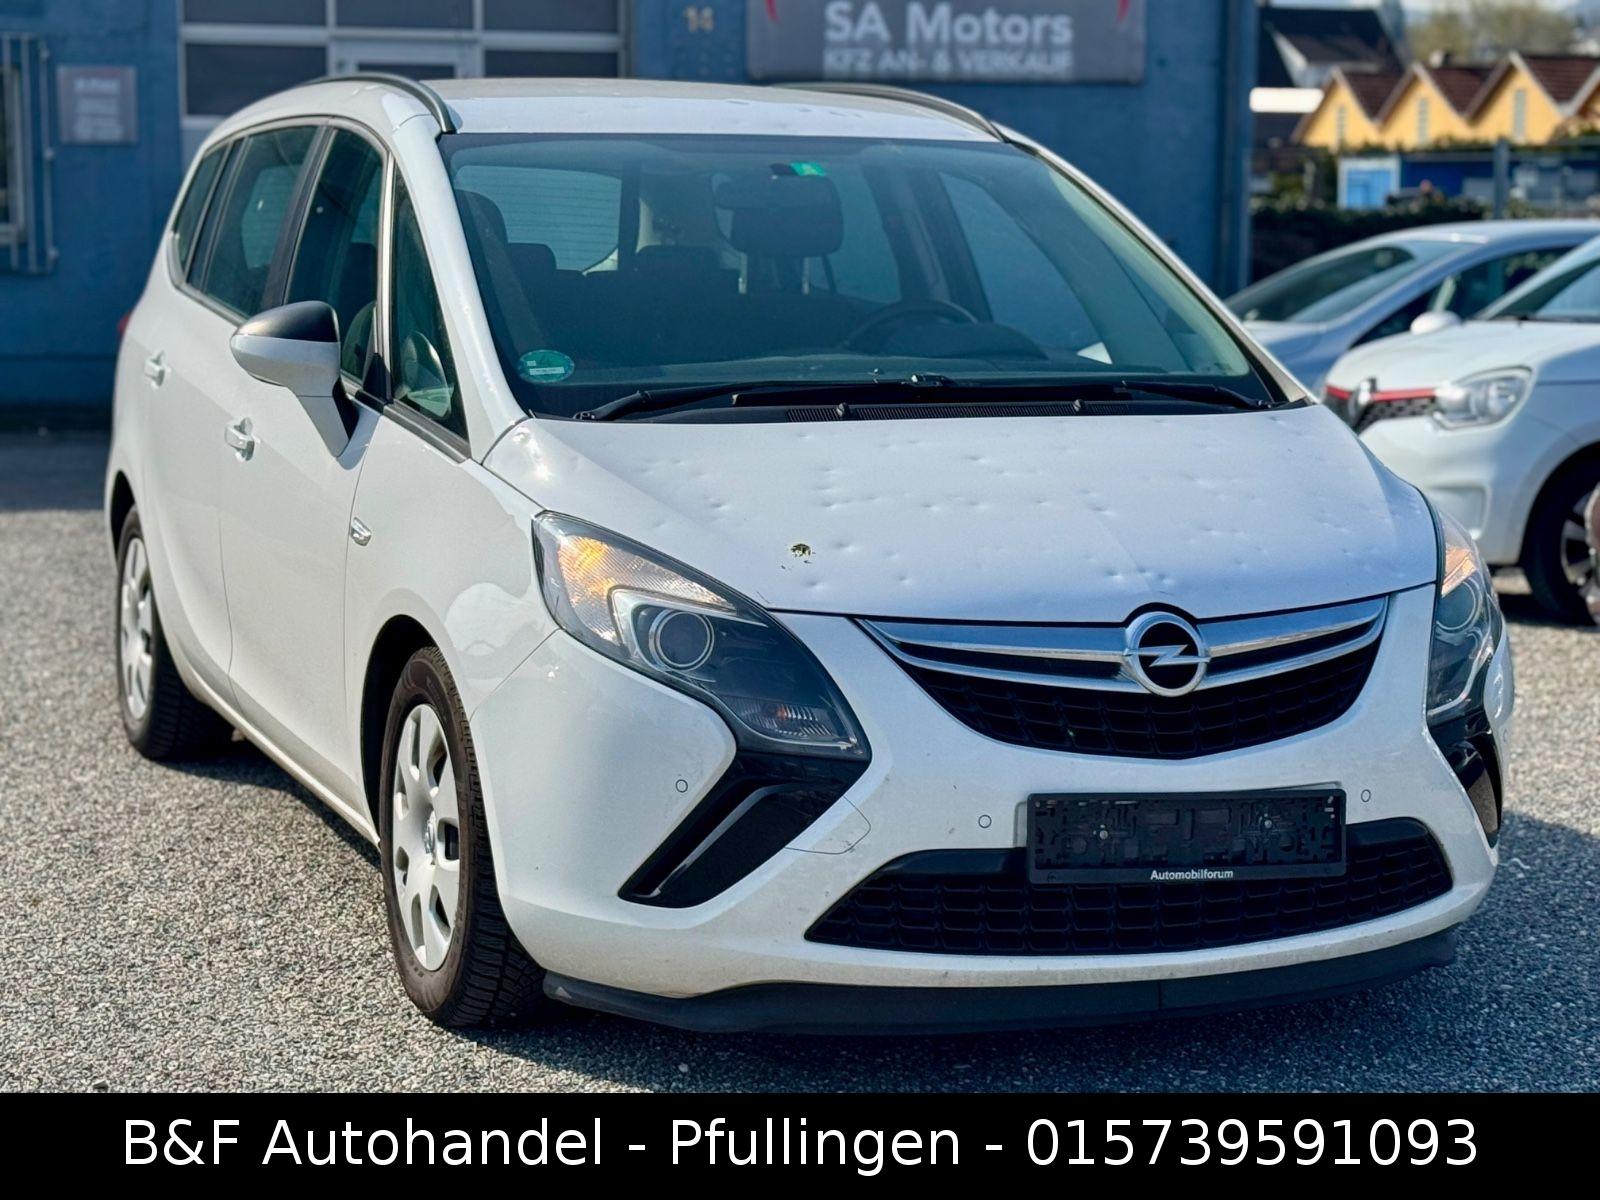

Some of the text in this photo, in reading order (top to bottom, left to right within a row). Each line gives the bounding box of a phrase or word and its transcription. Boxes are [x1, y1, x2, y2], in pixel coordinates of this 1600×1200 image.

[824, 0, 1074, 46] SA Motors
[824, 49, 872, 76] KFZ
[931, 49, 951, 76] &
[956, 49, 1074, 76] VERKAUF
[1150, 868, 1234, 881] Automobilforum
